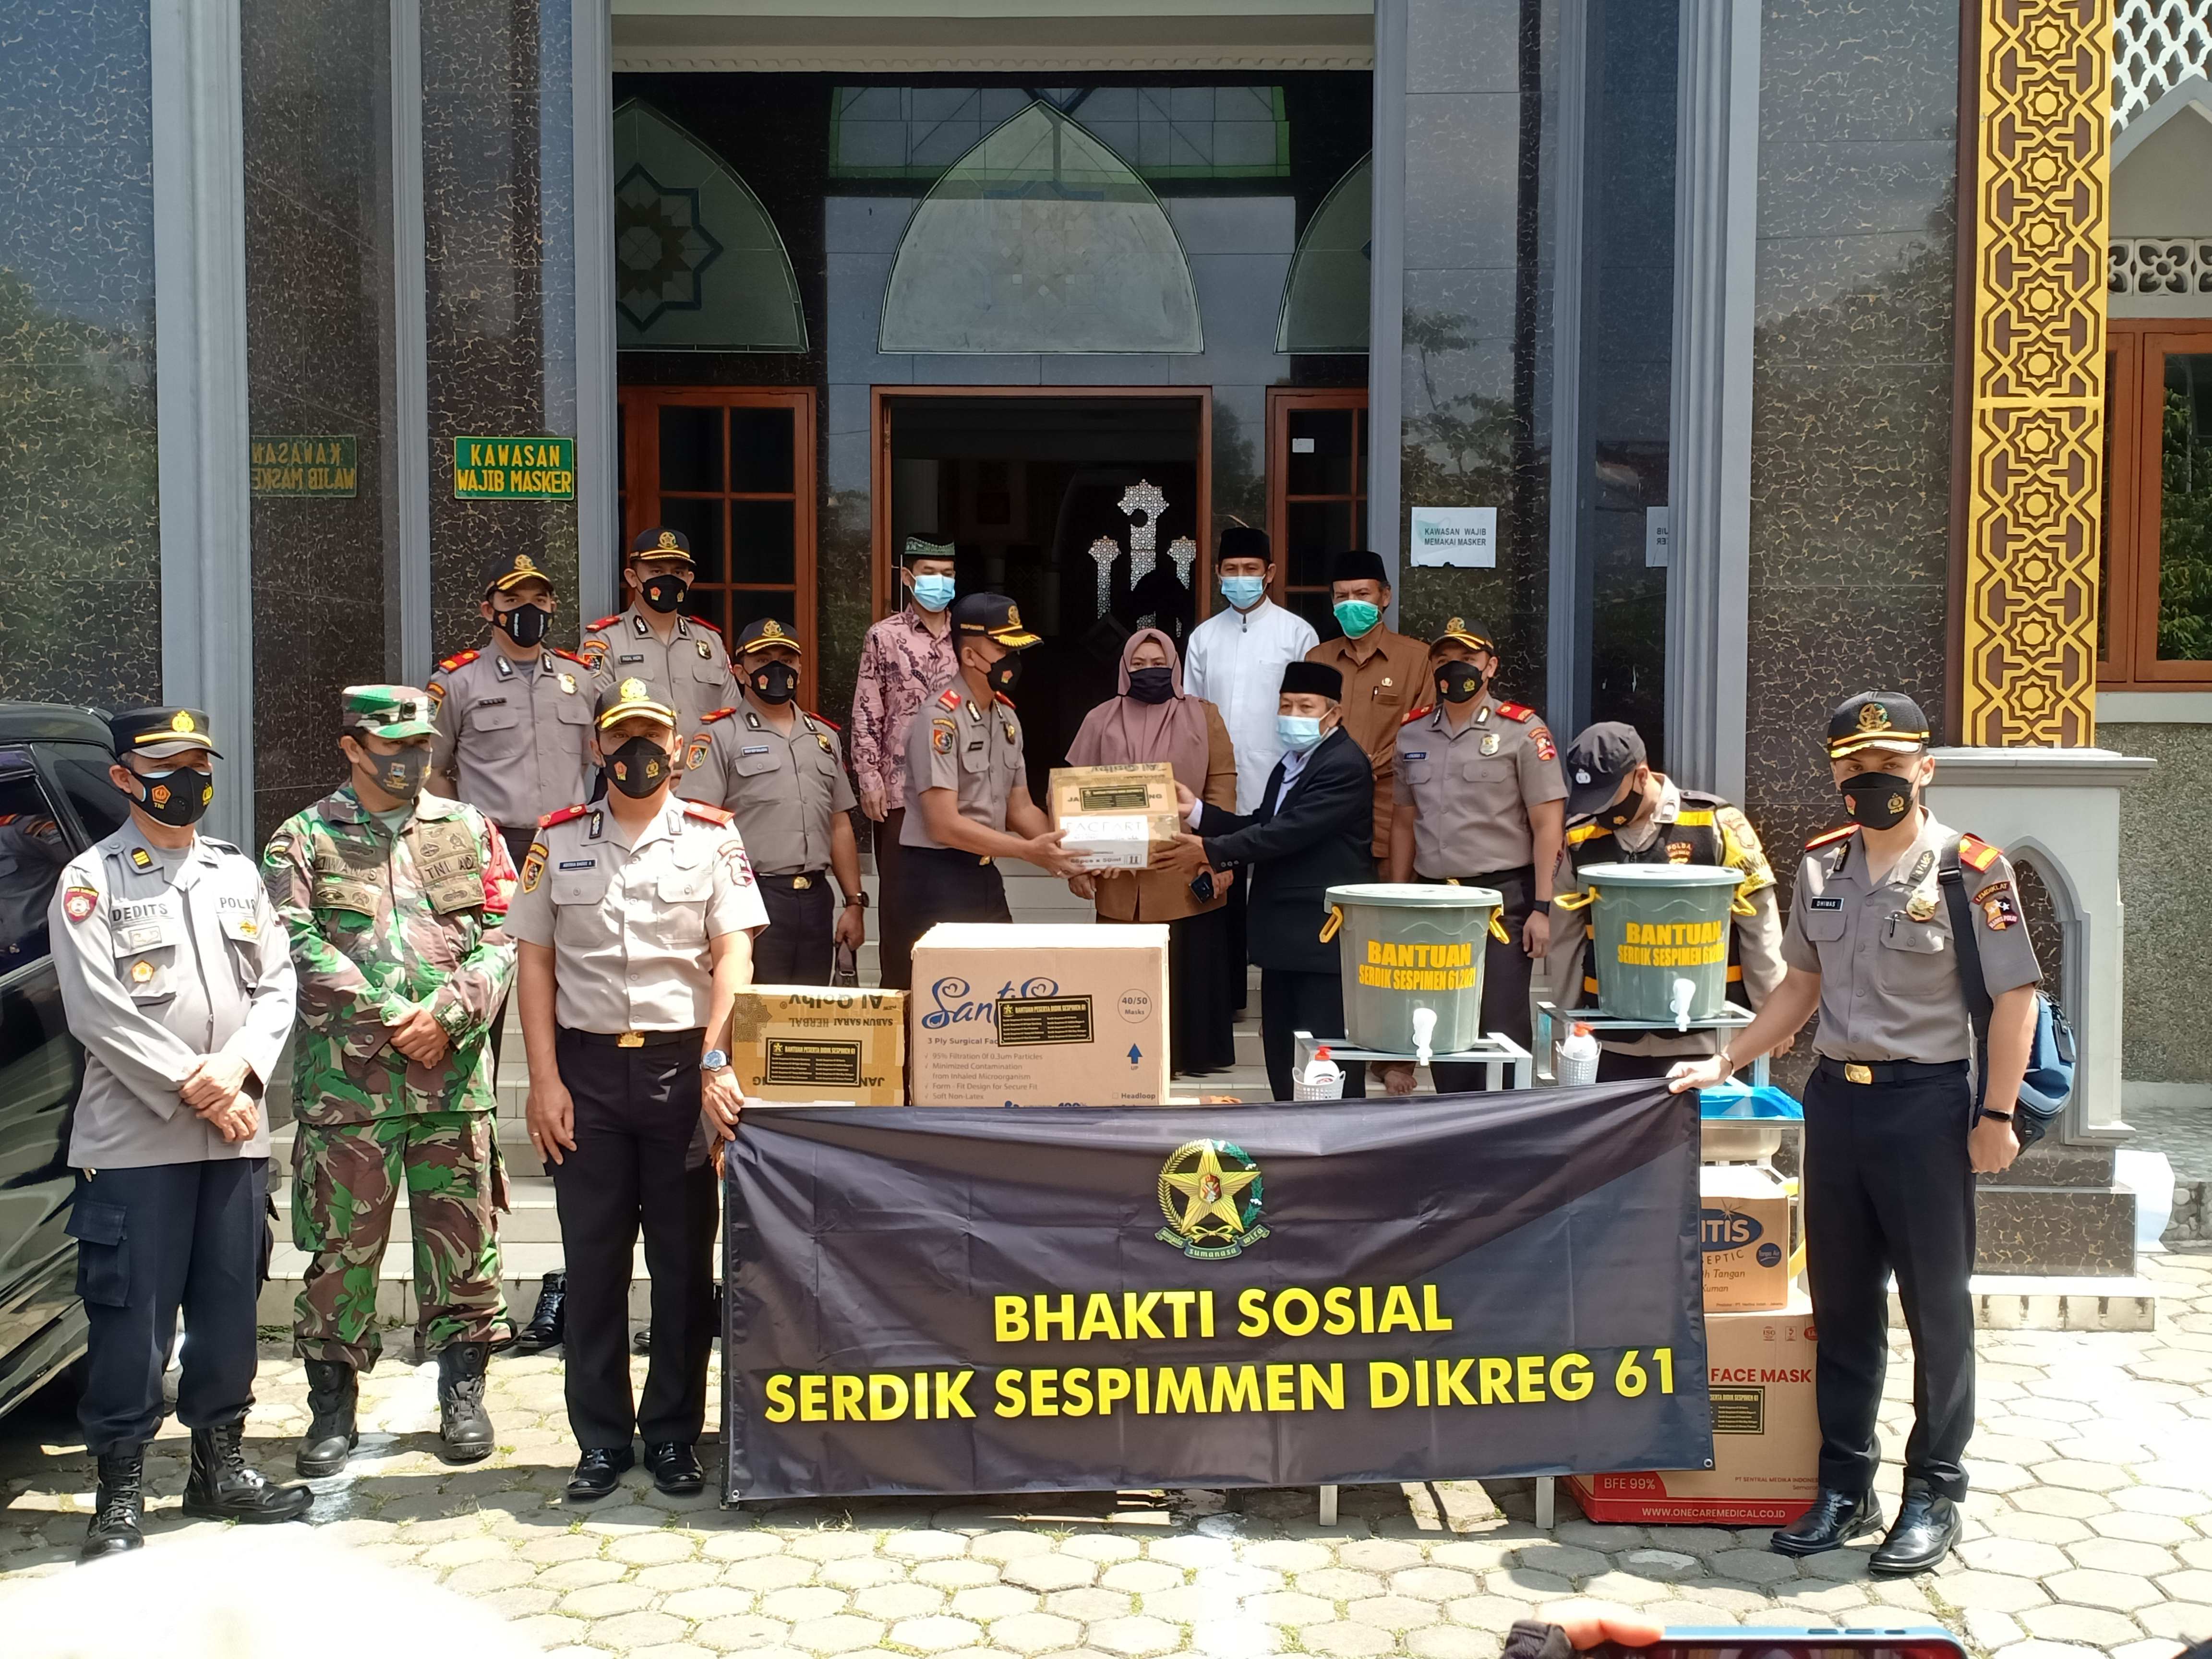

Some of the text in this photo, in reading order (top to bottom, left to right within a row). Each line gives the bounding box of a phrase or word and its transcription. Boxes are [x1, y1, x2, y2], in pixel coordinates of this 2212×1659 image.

[471, 444, 560, 467] KAWASAN
[457, 469, 571, 493] WAJIB MASKER
[1667, 843, 1691, 852] POLDA
[425, 861, 452, 879] TNI
[1975, 883, 2008, 902] LEMDIKLAT
[111, 903, 168, 922] DEDITS
[1626, 920, 1721, 945] BANTUAN
[1368, 940, 1471, 968] BANTUAN
[1617, 944, 1651, 966] SERDIK
[1653, 947, 1702, 967] SESPIMEN
[1358, 964, 1392, 989] SERDIK
[1393, 969, 1446, 991] SESPIMEN
[862, 994, 884, 1009] Al
[789, 1017, 829, 1028] HERBAL
[863, 1018, 893, 1026] SABUN
[935, 1037, 947, 1046] Ply
[950, 1037, 982, 1046] Surgical
[979, 1073, 1031, 1082] Microorganism
[967, 1083, 991, 1091] Design
[1243, 1228, 1263, 1244] wira
[1189, 1248, 1237, 1258] sumanasa
[1706, 1250, 1744, 1264] EPTIC
[1713, 1269, 1745, 1280] Tangan
[994, 1284, 1453, 1343] BHAKTI SOSIAL
[1711, 1368, 1812, 1383] FACE MASK
[764, 1347, 1674, 1423] SERDIK SESPIMMEN DIKREG 61
[1604, 1478, 1656, 1490] BFE 99%
[1642, 1507, 1786, 1518] WWW.ONECAREMEDICAL.CO.ID
